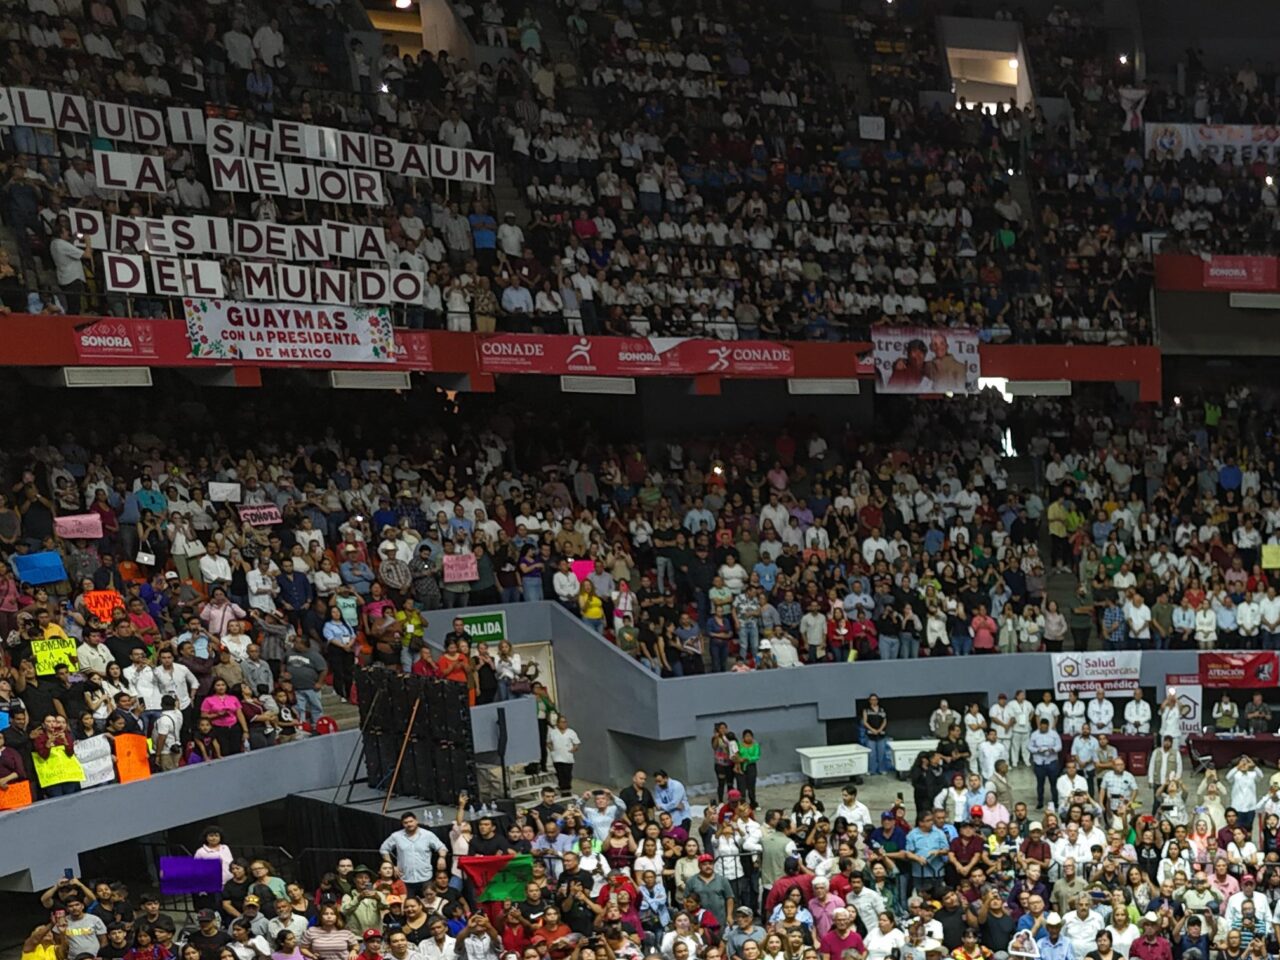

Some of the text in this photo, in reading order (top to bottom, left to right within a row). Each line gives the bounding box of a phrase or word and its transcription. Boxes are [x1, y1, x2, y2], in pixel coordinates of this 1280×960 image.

[213, 124, 492, 181] SHEINBAUM
[101, 154, 379, 201] LA MEJOR
[75, 212, 386, 260] PRESIDENTA
[109, 257, 421, 301] DEL MUNDO
[226, 306, 348, 330] GUAYMAS
[81, 335, 133, 348] SONORA
[221, 330, 361, 346] CON LA PRESIDENTA
[256, 346, 332, 359] DE MÉXICO
[481, 342, 544, 356] CONADE
[732, 349, 791, 362] CONADE
[618, 352, 661, 362] SONORA
[463, 621, 502, 637] SALIDA
[1084, 657, 1116, 668] Salud
[1208, 667, 1246, 676] ATENCIÓN
[1059, 679, 1140, 692] Atención médica
